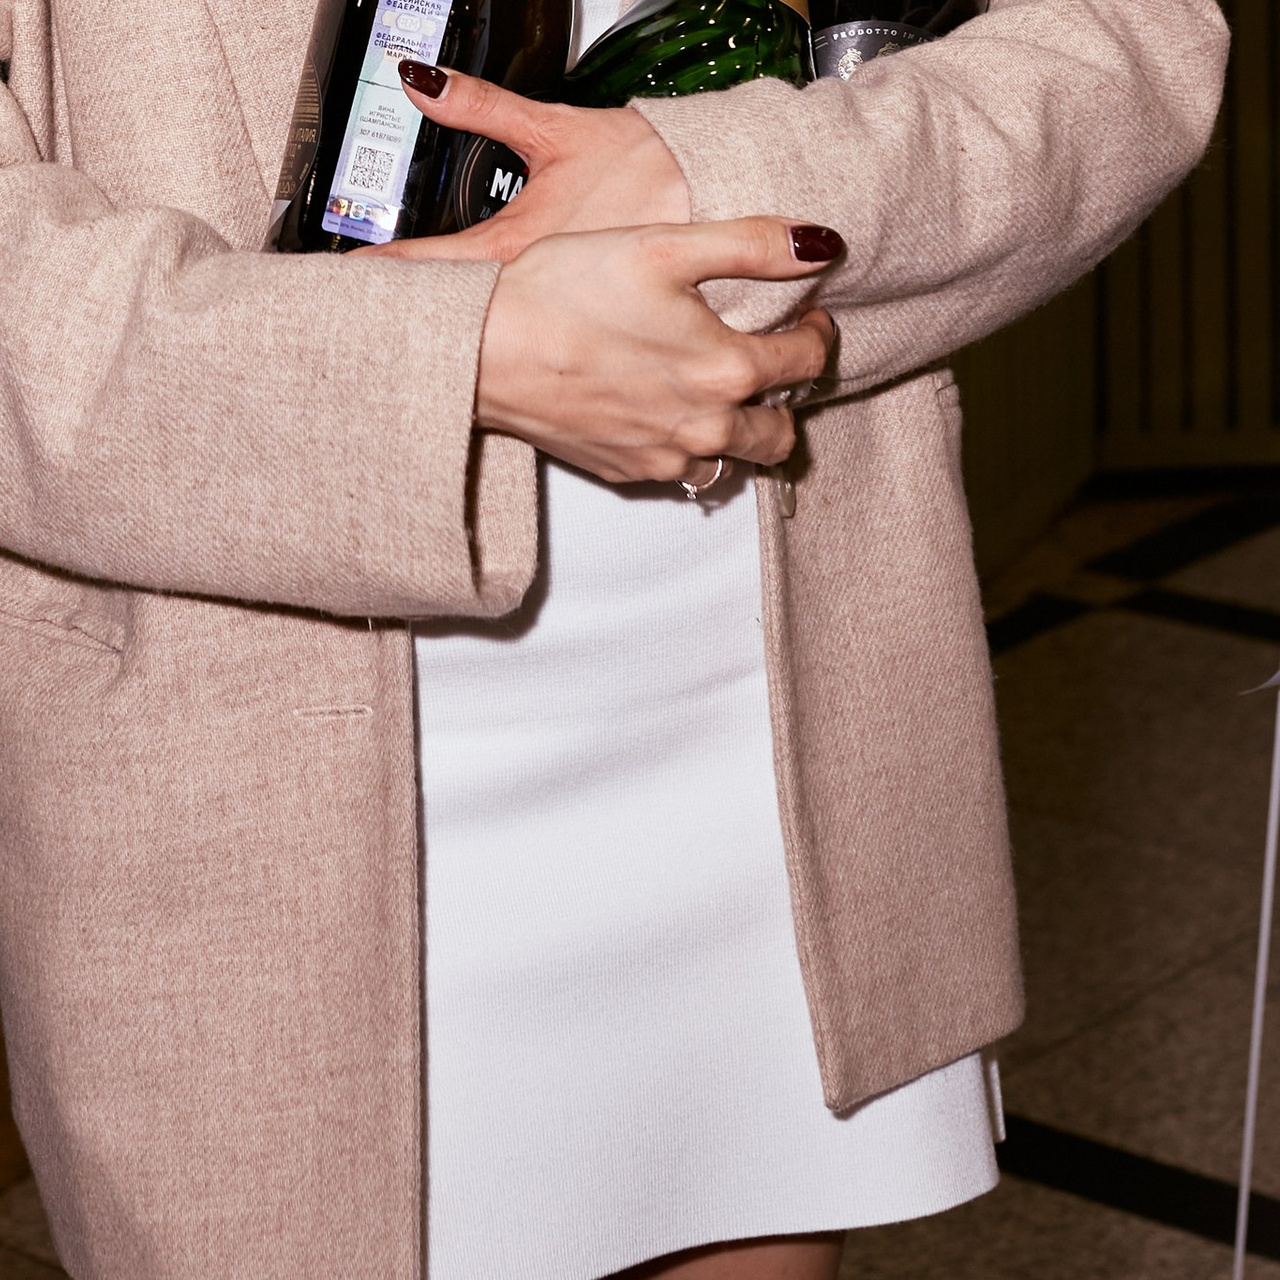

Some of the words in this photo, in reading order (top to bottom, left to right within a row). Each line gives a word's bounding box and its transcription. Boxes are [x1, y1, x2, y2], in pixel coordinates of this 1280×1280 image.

[386, 0, 441, 16] ФЕДЕРАЦИЯ
[376, 32, 433, 50] ФЕДЕРАЛЬНАЯ
[832, 28, 898, 40] PRODOTTO
